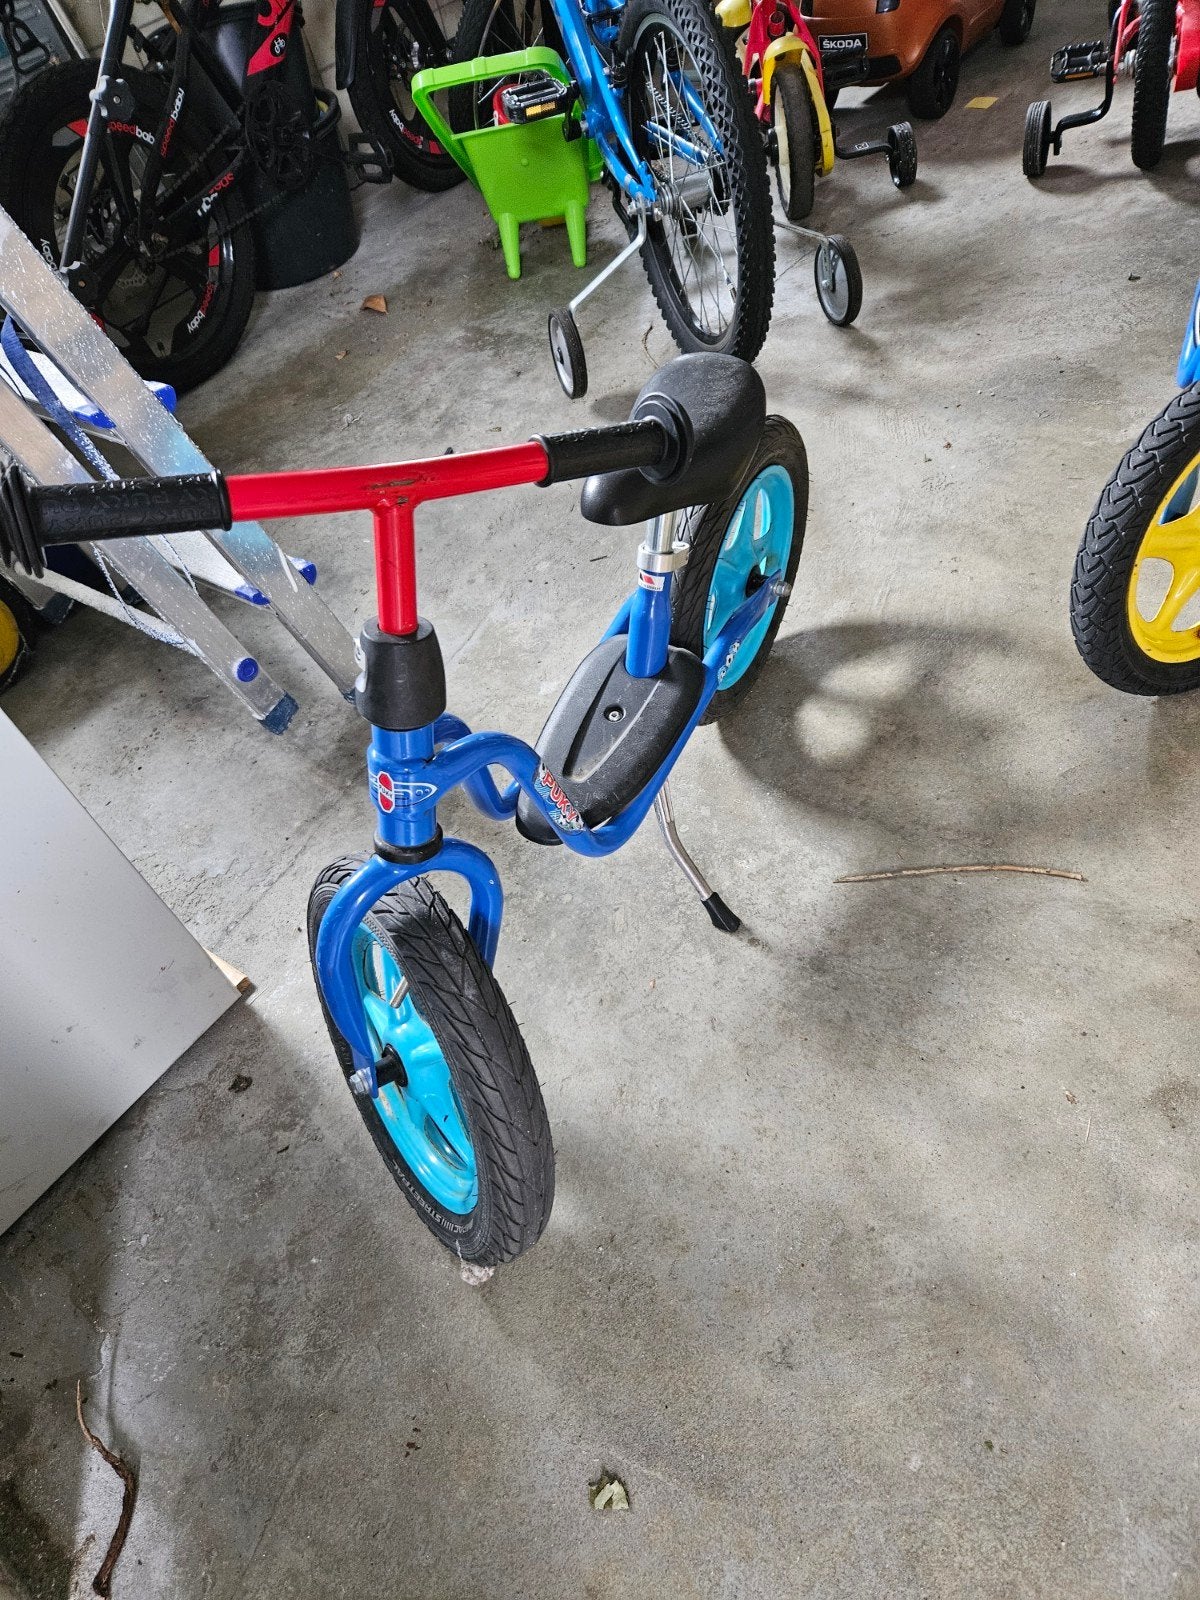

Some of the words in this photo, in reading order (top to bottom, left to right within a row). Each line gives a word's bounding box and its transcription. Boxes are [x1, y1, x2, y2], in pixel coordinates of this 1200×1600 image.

[822, 38, 862, 49] ŠKODA
[106, 121, 155, 145] peedbab
[541, 769, 578, 822] PUKY
